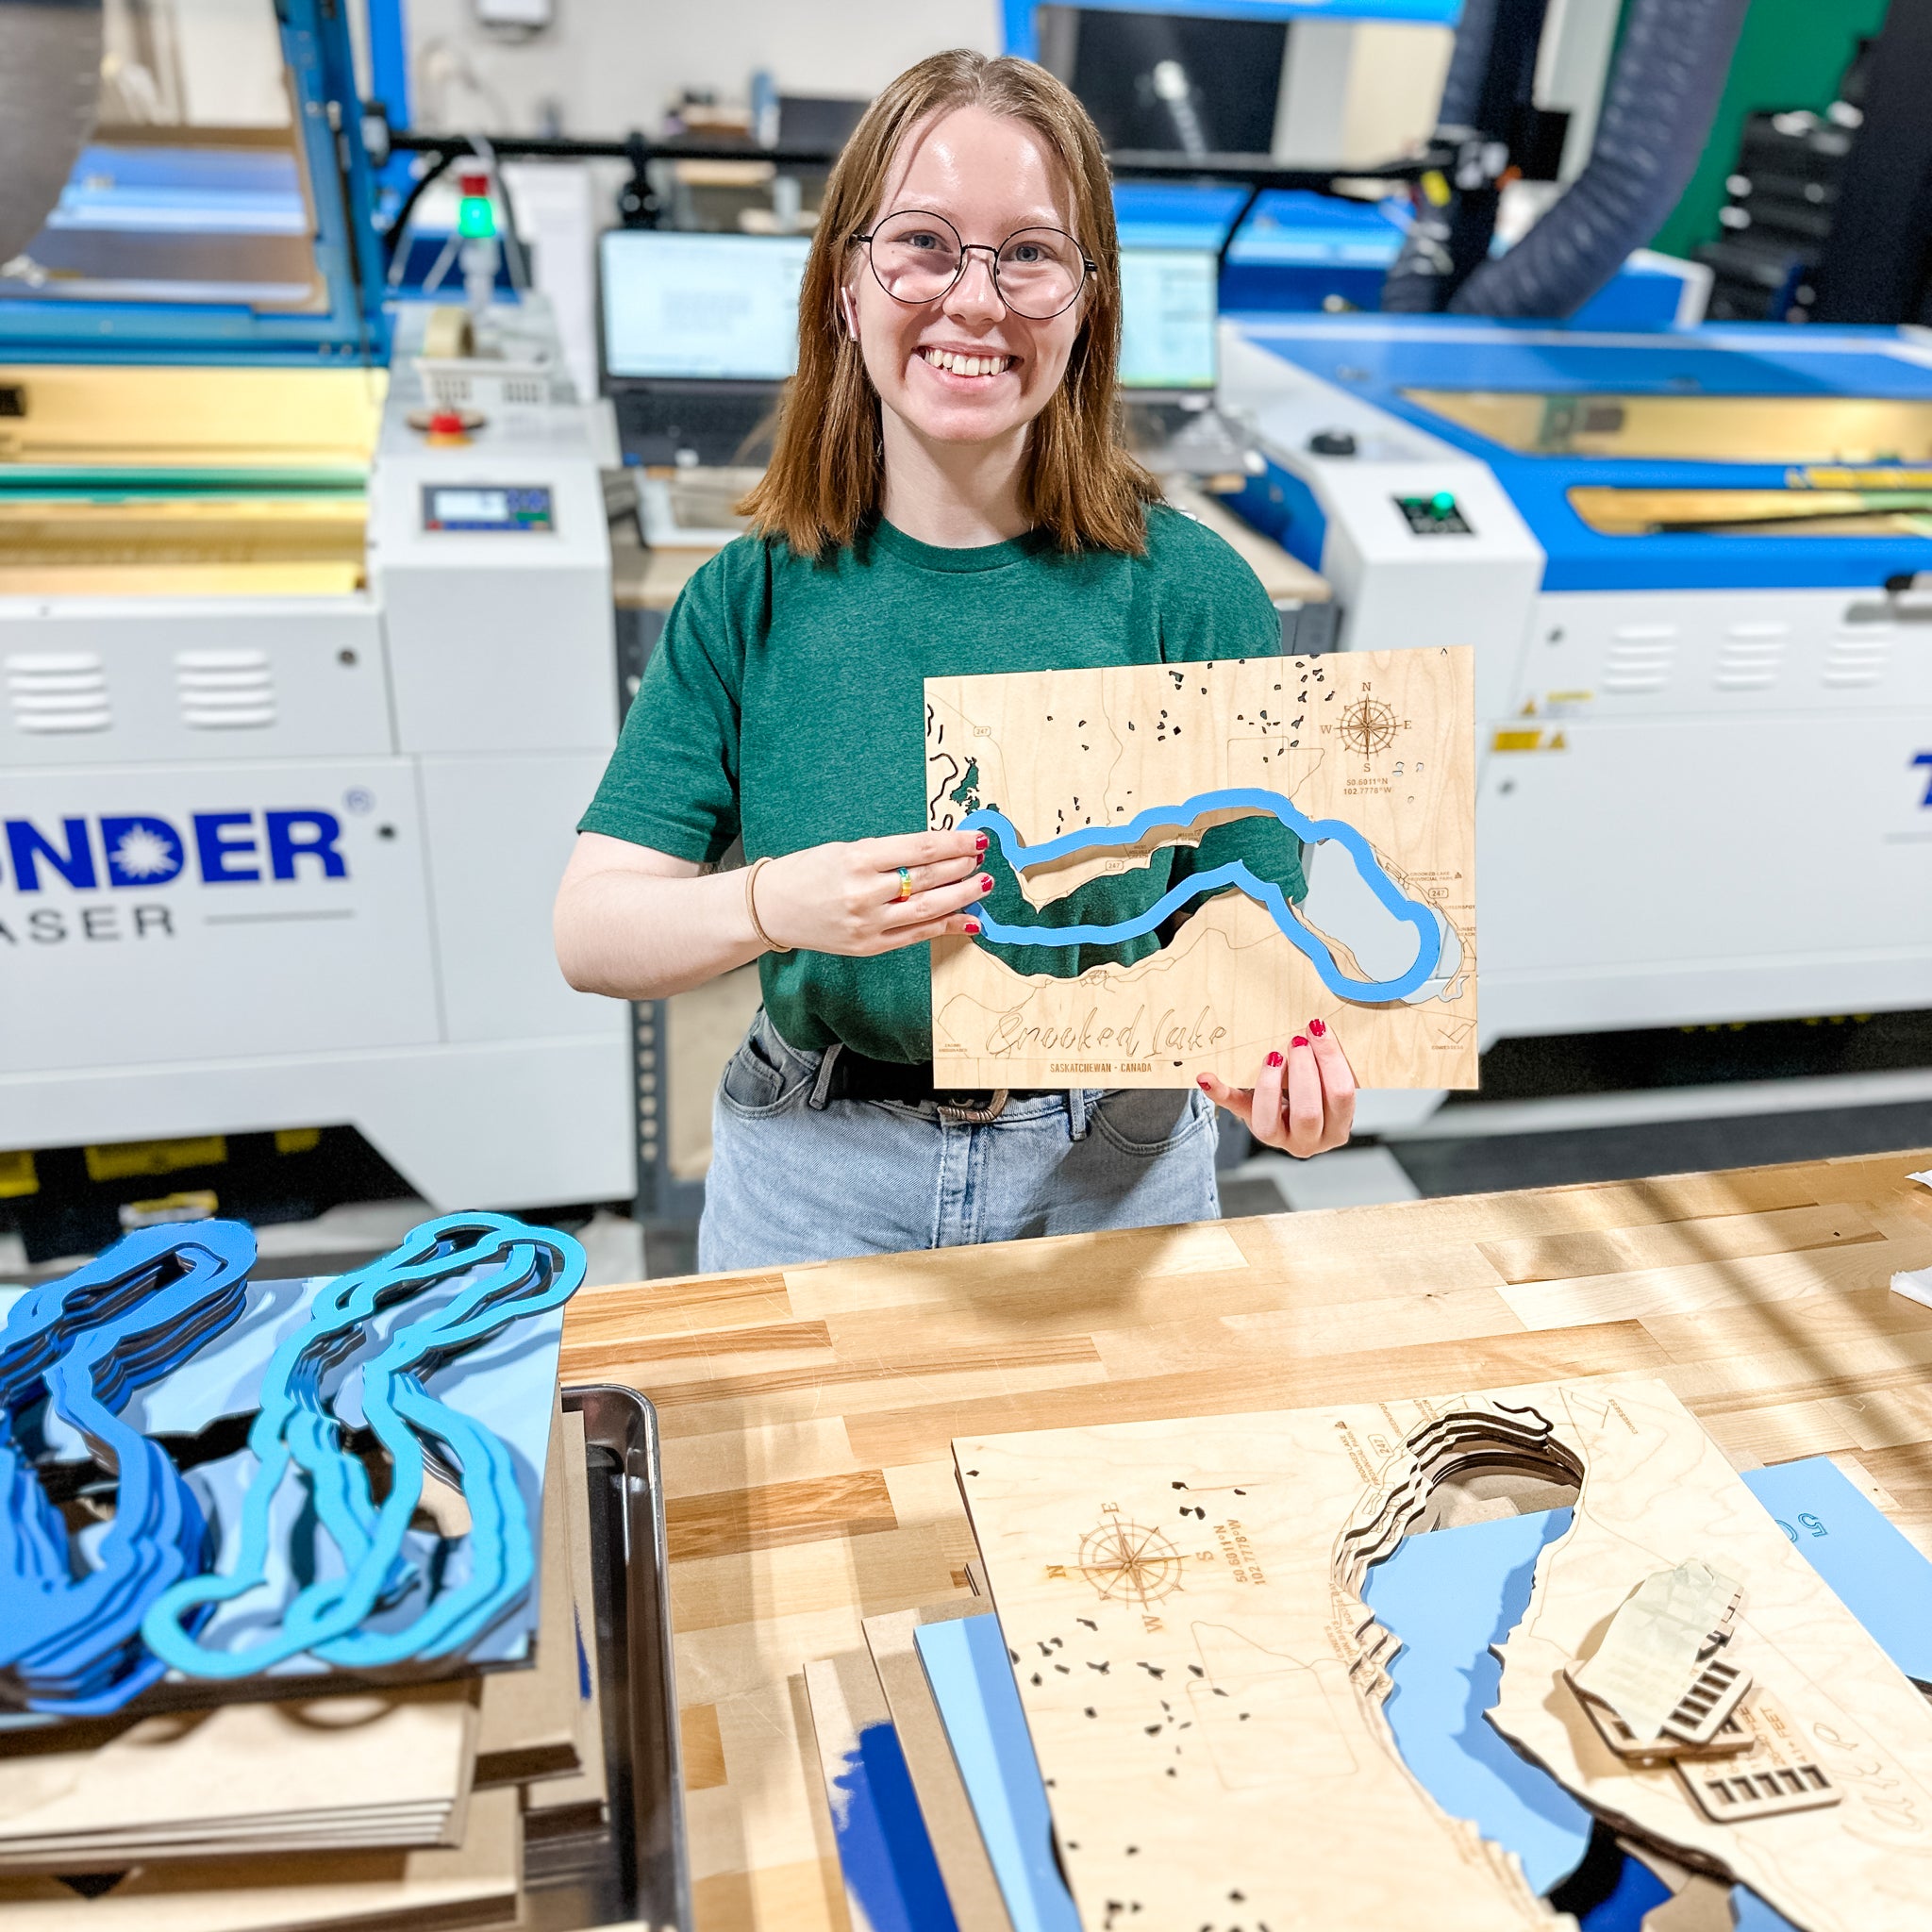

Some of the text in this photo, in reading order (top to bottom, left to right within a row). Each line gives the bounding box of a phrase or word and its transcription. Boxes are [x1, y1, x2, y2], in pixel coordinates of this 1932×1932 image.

[1362, 682, 1372, 691] N
[1320, 724, 1333, 734] W
[1404, 720, 1412, 730] E
[1363, 762, 1371, 773] S
[0, 809, 346, 891] NDER
[986, 1005, 1144, 1059] Crooked
[1050, 1063, 1111, 1073] SASKATCHEWAN
[1121, 1063, 1152, 1073] CANADA
[1379, 1403, 1403, 1438] GREENSPOT
[1374, 1439, 1390, 1454] 247
[1340, 1435, 1370, 1483] CROOKED LAKE
[1346, 1430, 1380, 1486] PROVINCIAL PARK
[1101, 1501, 1120, 1514] E
[1195, 1551, 1215, 1562] S
[1046, 1564, 1067, 1578] N
[1141, 1614, 1163, 1634] W
[1758, 1706, 1791, 1739] FEET
